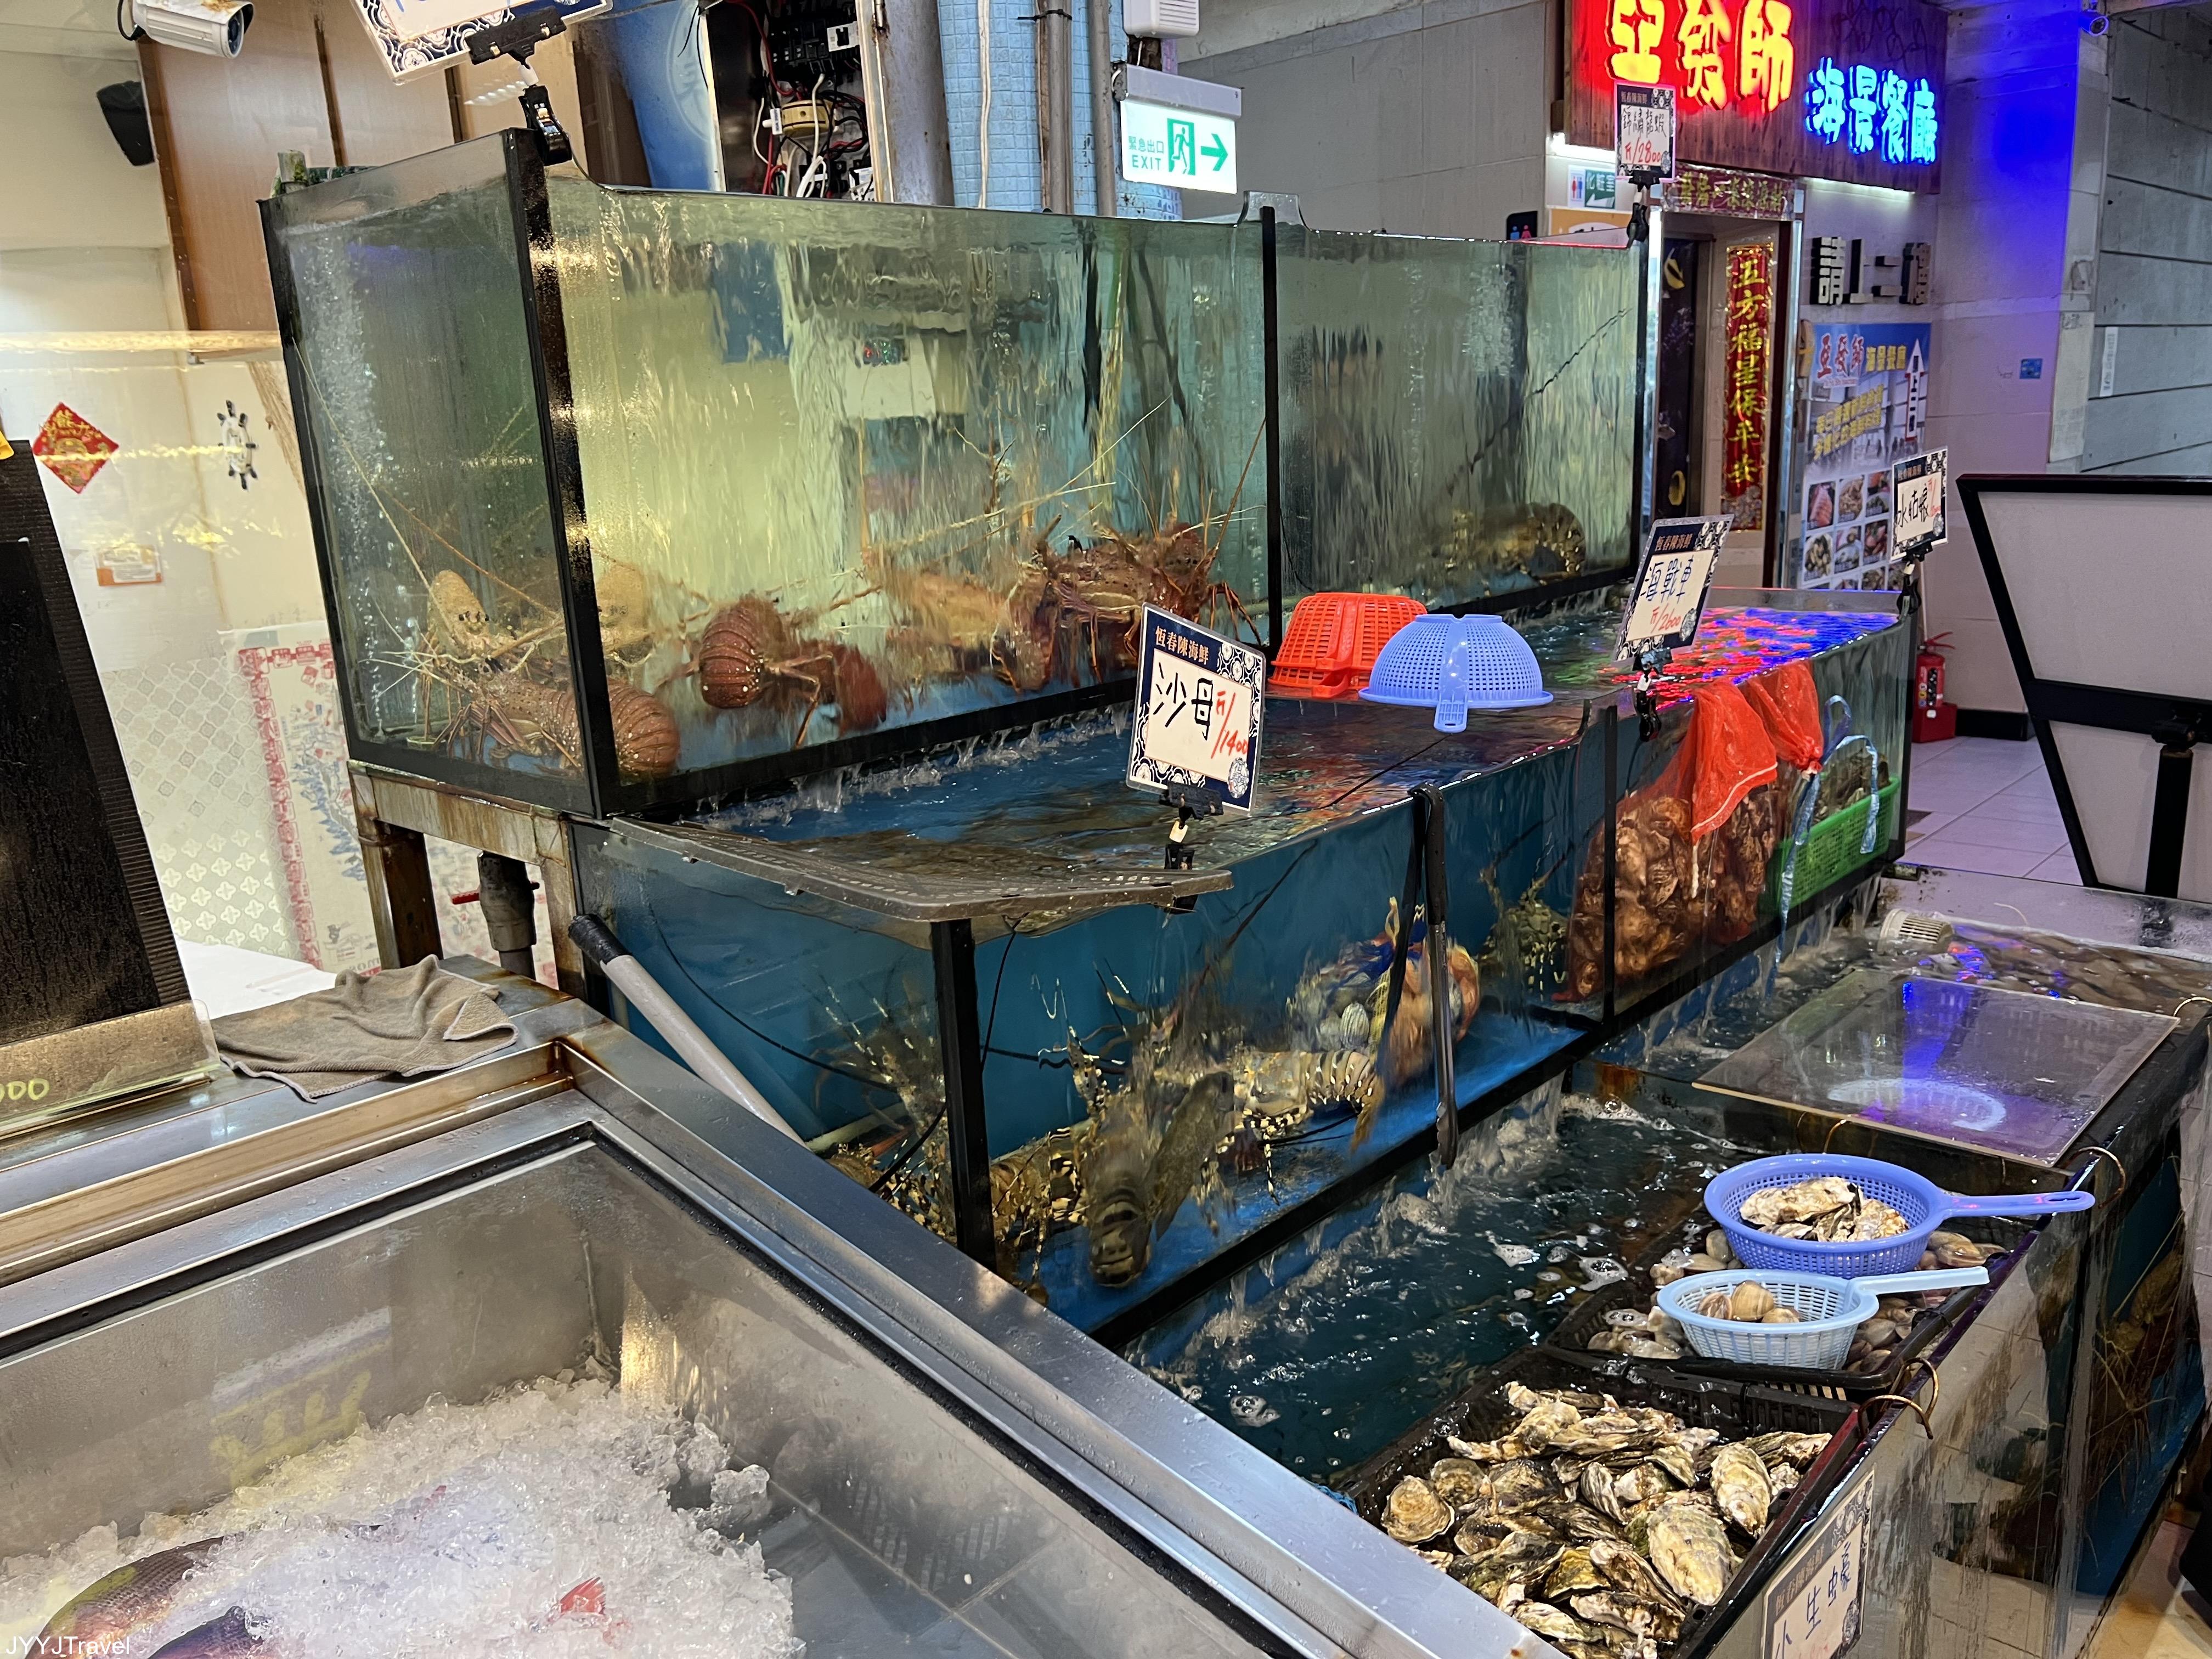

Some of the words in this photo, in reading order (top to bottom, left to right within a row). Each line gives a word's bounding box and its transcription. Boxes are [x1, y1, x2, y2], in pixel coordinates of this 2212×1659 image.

[1805, 57, 1938, 165] 海景餐廳
[1128, 136, 1164, 154] 緊急出口
[1132, 154, 1161, 171] EXIT
[1809, 236, 1932, 305] 請上二樓
[1640, 554, 1694, 605] 海戰車
[1155, 625, 1209, 665] 恆春陳海鮮
[1153, 662, 1214, 741] 沙母
